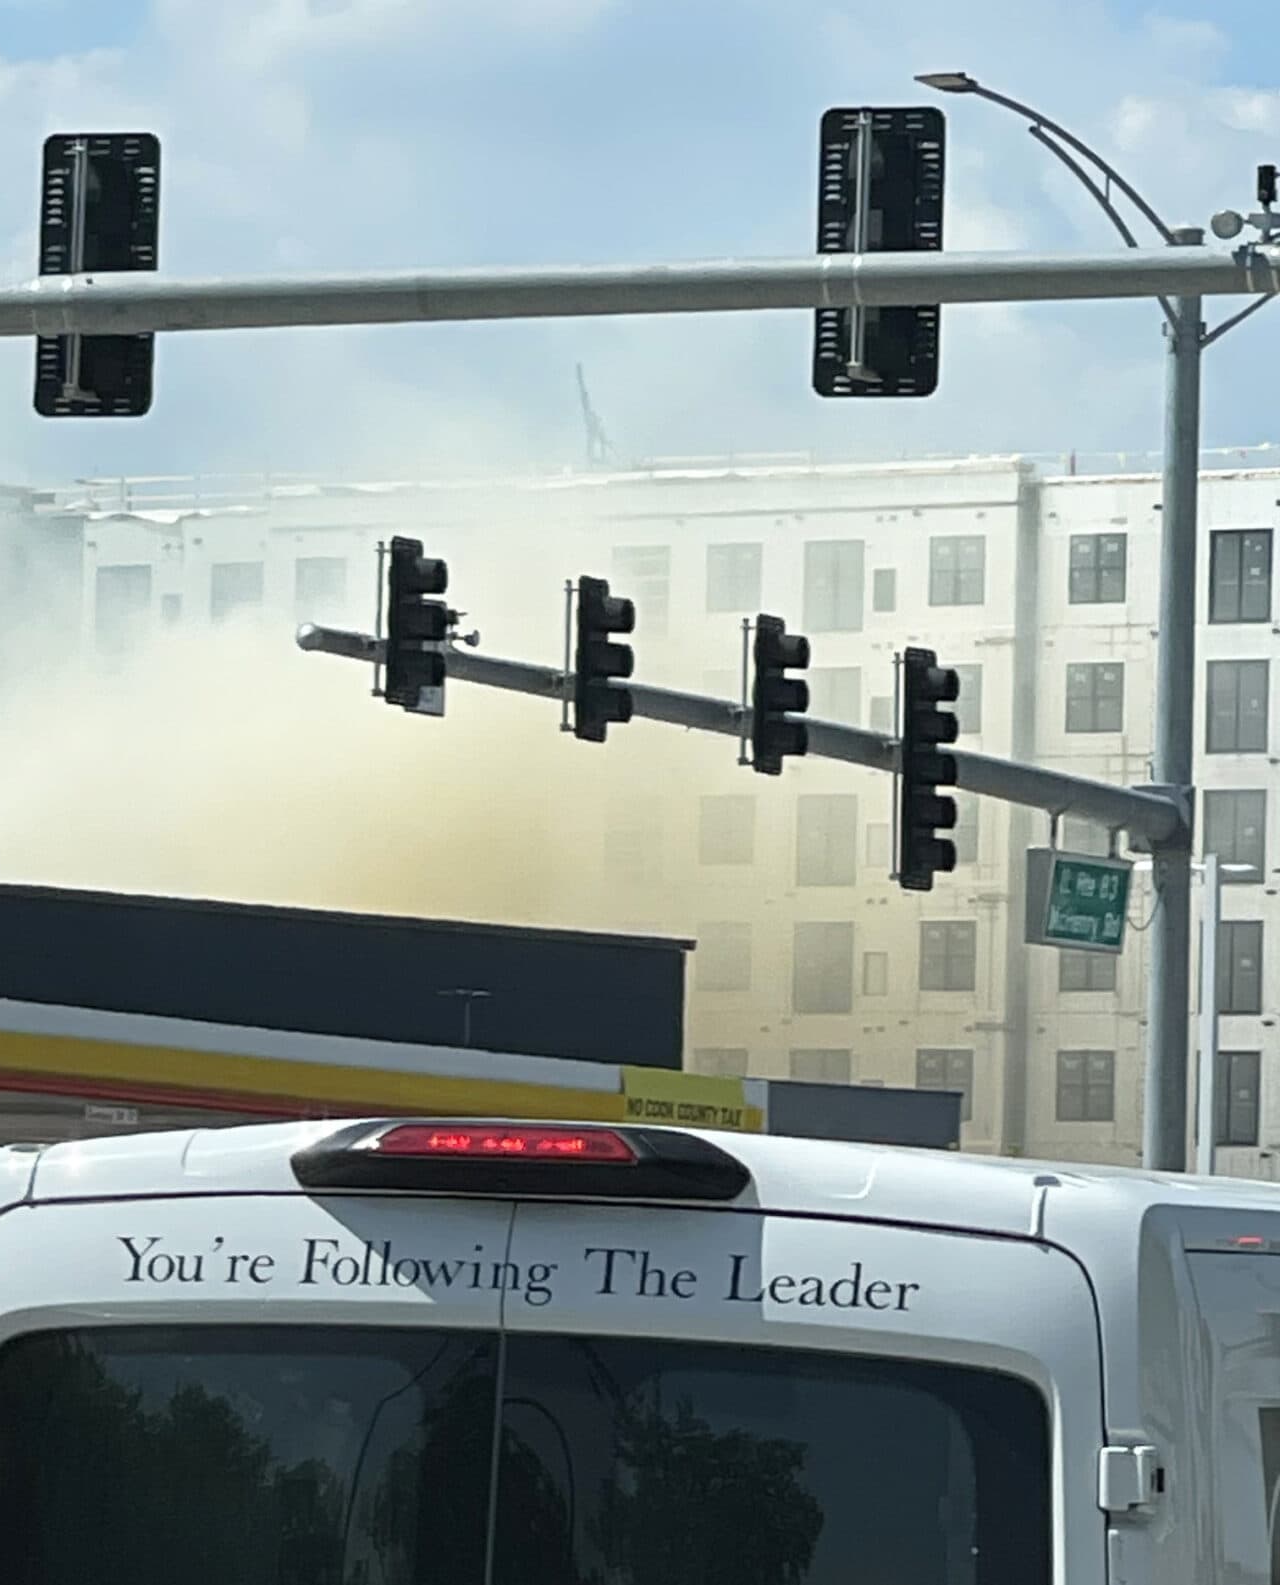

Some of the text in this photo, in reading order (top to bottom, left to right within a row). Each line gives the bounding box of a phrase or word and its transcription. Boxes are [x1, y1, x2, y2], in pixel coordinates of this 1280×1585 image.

[627, 1098, 744, 1127] NO COOK COUNTY TAX
[116, 1236, 921, 1312] You're Following The Leader
